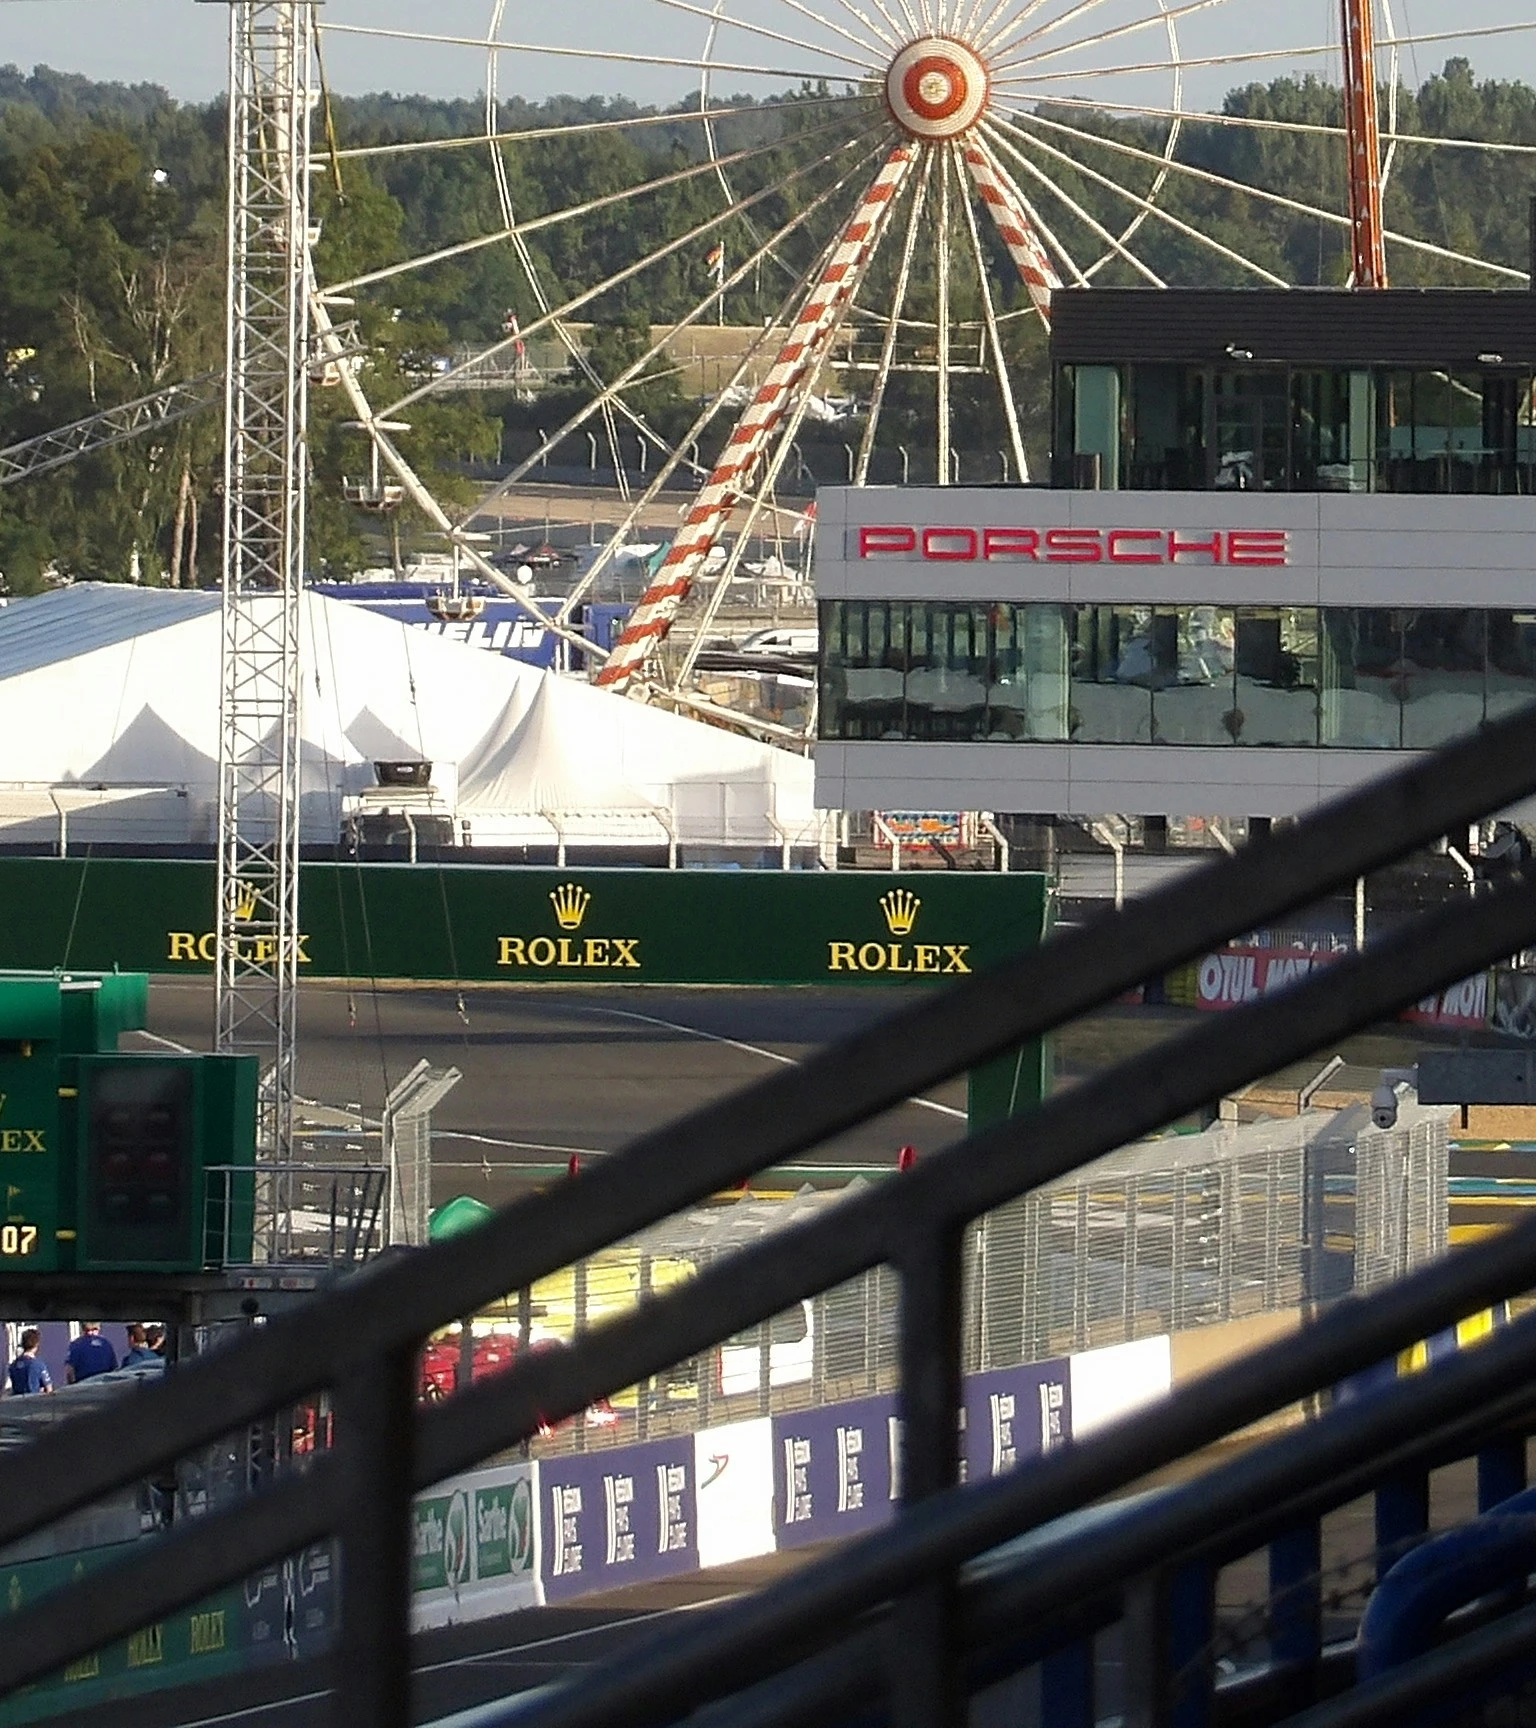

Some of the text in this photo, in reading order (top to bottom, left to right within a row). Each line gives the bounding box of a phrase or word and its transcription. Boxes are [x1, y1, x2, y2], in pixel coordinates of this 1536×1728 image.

[858, 525, 1290, 566] PORSCHE
[497, 937, 641, 968] ROLEX
[828, 941, 972, 973] ROLEX
[0, 1225, 38, 1255] 07
[478, 1495, 507, 1545] Sarthe
